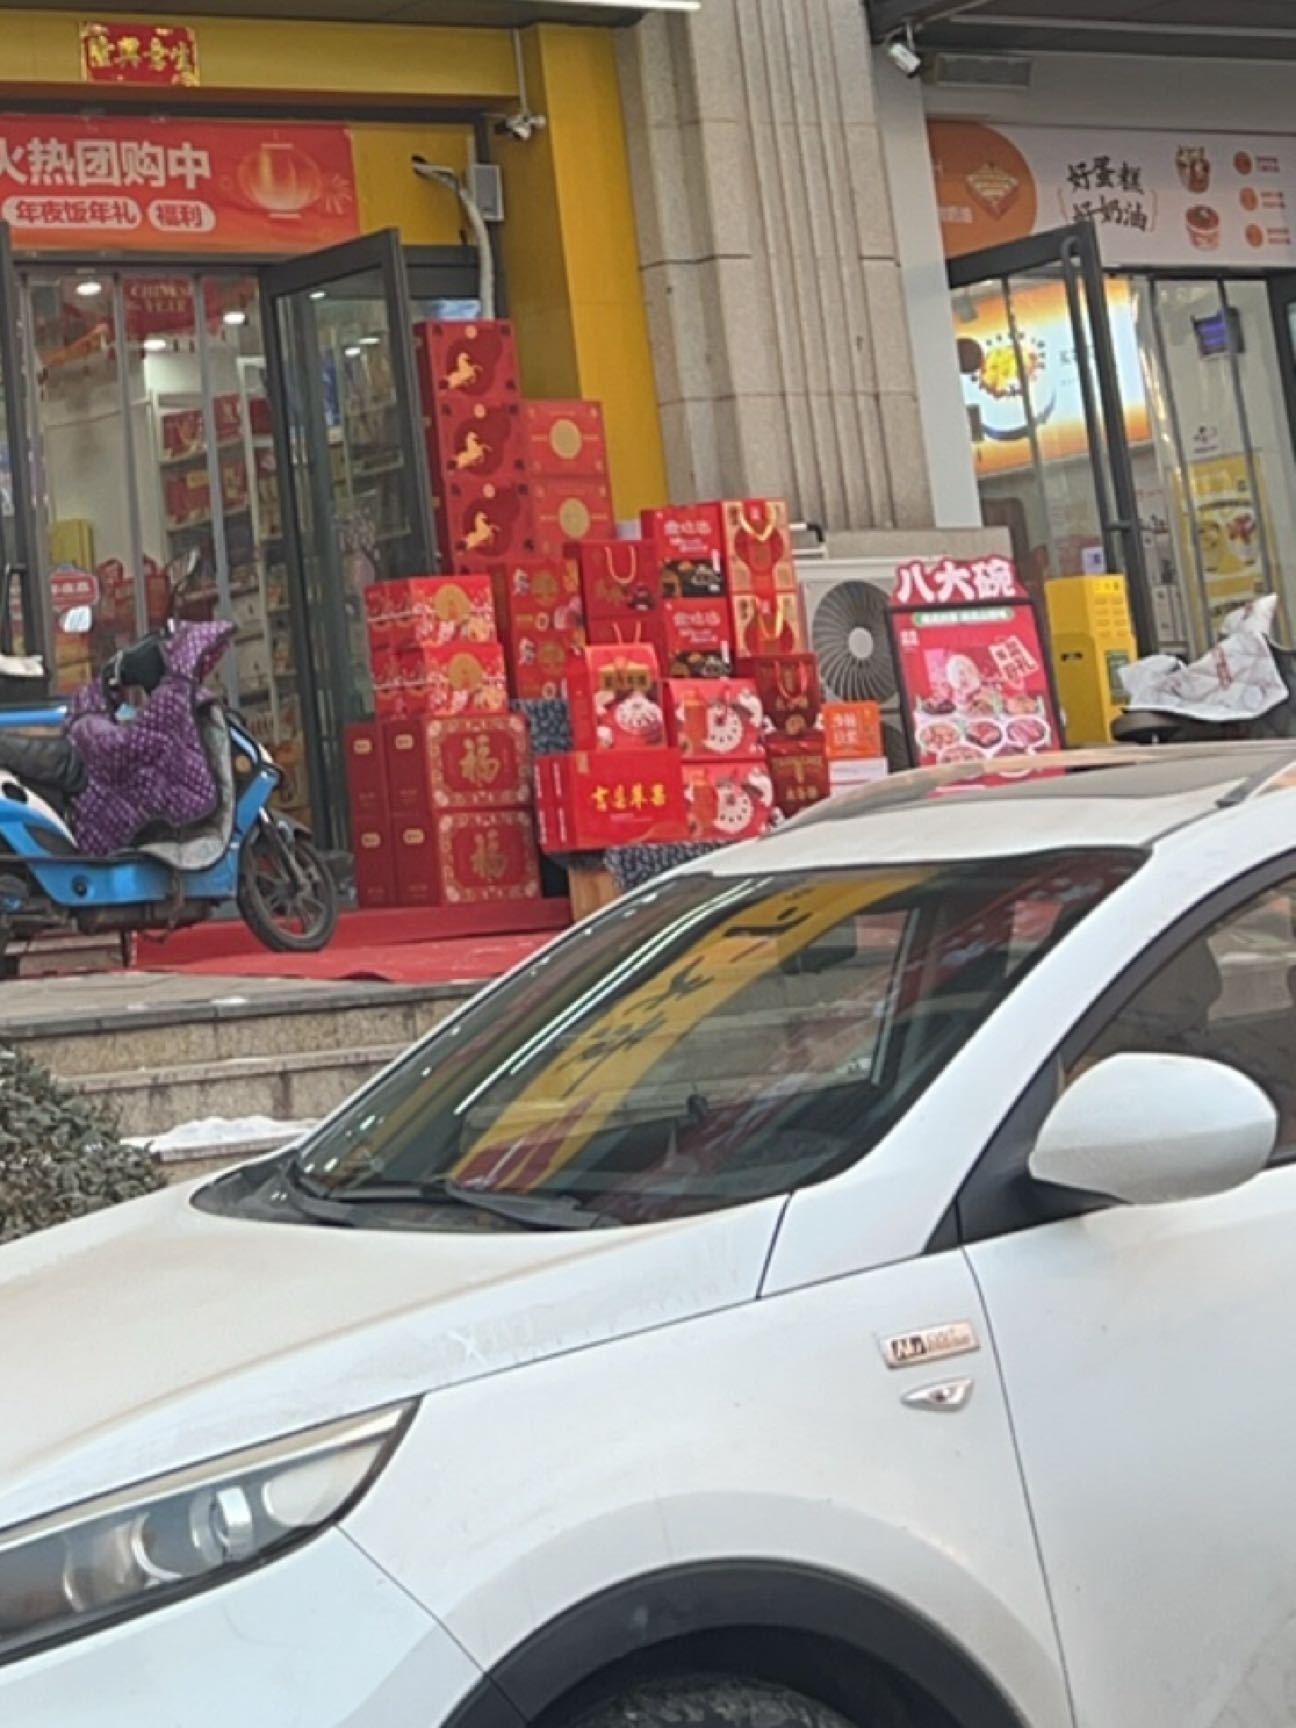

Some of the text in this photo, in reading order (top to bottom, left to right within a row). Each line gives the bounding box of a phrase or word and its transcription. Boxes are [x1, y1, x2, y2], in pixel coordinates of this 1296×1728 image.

[1067, 156, 1145, 194] 好蛋糕
[17, 199, 136, 225] 年夜饭年礼
[156, 204, 202, 227] 福利
[898, 559, 1016, 603] 八大碗
